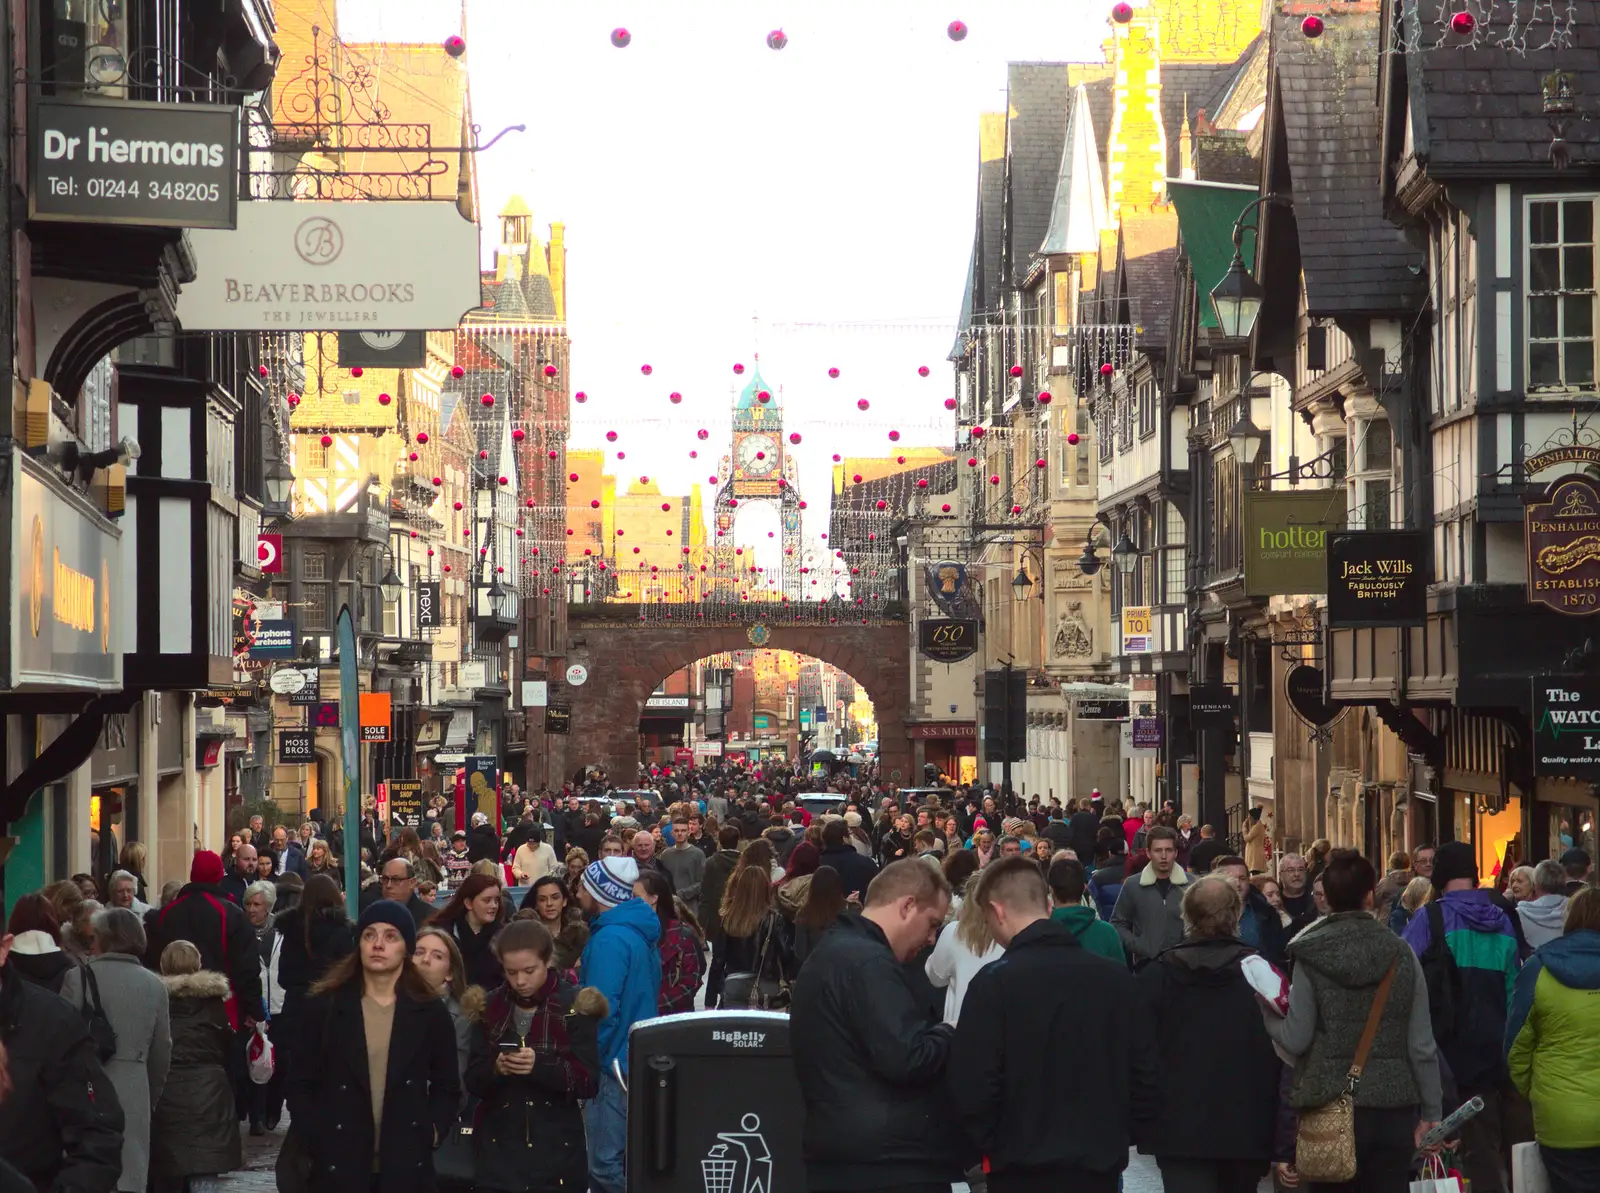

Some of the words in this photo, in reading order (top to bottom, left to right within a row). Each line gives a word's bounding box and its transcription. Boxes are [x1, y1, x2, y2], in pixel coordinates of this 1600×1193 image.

[44, 129, 80, 161] Dr
[88, 126, 225, 167] hermans
[48, 176, 79, 196] Tel:
[87, 178, 140, 198] 01244
[148, 181, 220, 201] 348205
[224, 278, 415, 303] BEAVERBROOKS
[263, 311, 291, 322] THE
[299, 311, 379, 323] JEWELLERS
[1260, 527, 1327, 549] hotter
[1341, 560, 1373, 579] Jack
[1376, 559, 1413, 574] Wills
[1348, 581, 1405, 590] FABULOUSLY
[1357, 591, 1397, 599] BRITISH
[1563, 593, 1597, 606] 1870
[420, 587, 432, 623] next
[1126, 610, 1148, 619] PRIME
[933, 624, 964, 642] 150
[1128, 620, 1143, 633] TO
[255, 638, 292, 646] arehouse
[1546, 688, 1581, 702] The
[1549, 710, 1600, 724] WATC
[364, 726, 385, 734] SOLE
[922, 727, 939, 736] S.S.
[285, 746, 311, 754] BROS.
[1541, 756, 1569, 764] Quality
[712, 1030, 766, 1043] BigBelly
[733, 1040, 758, 1048] SOLAR
